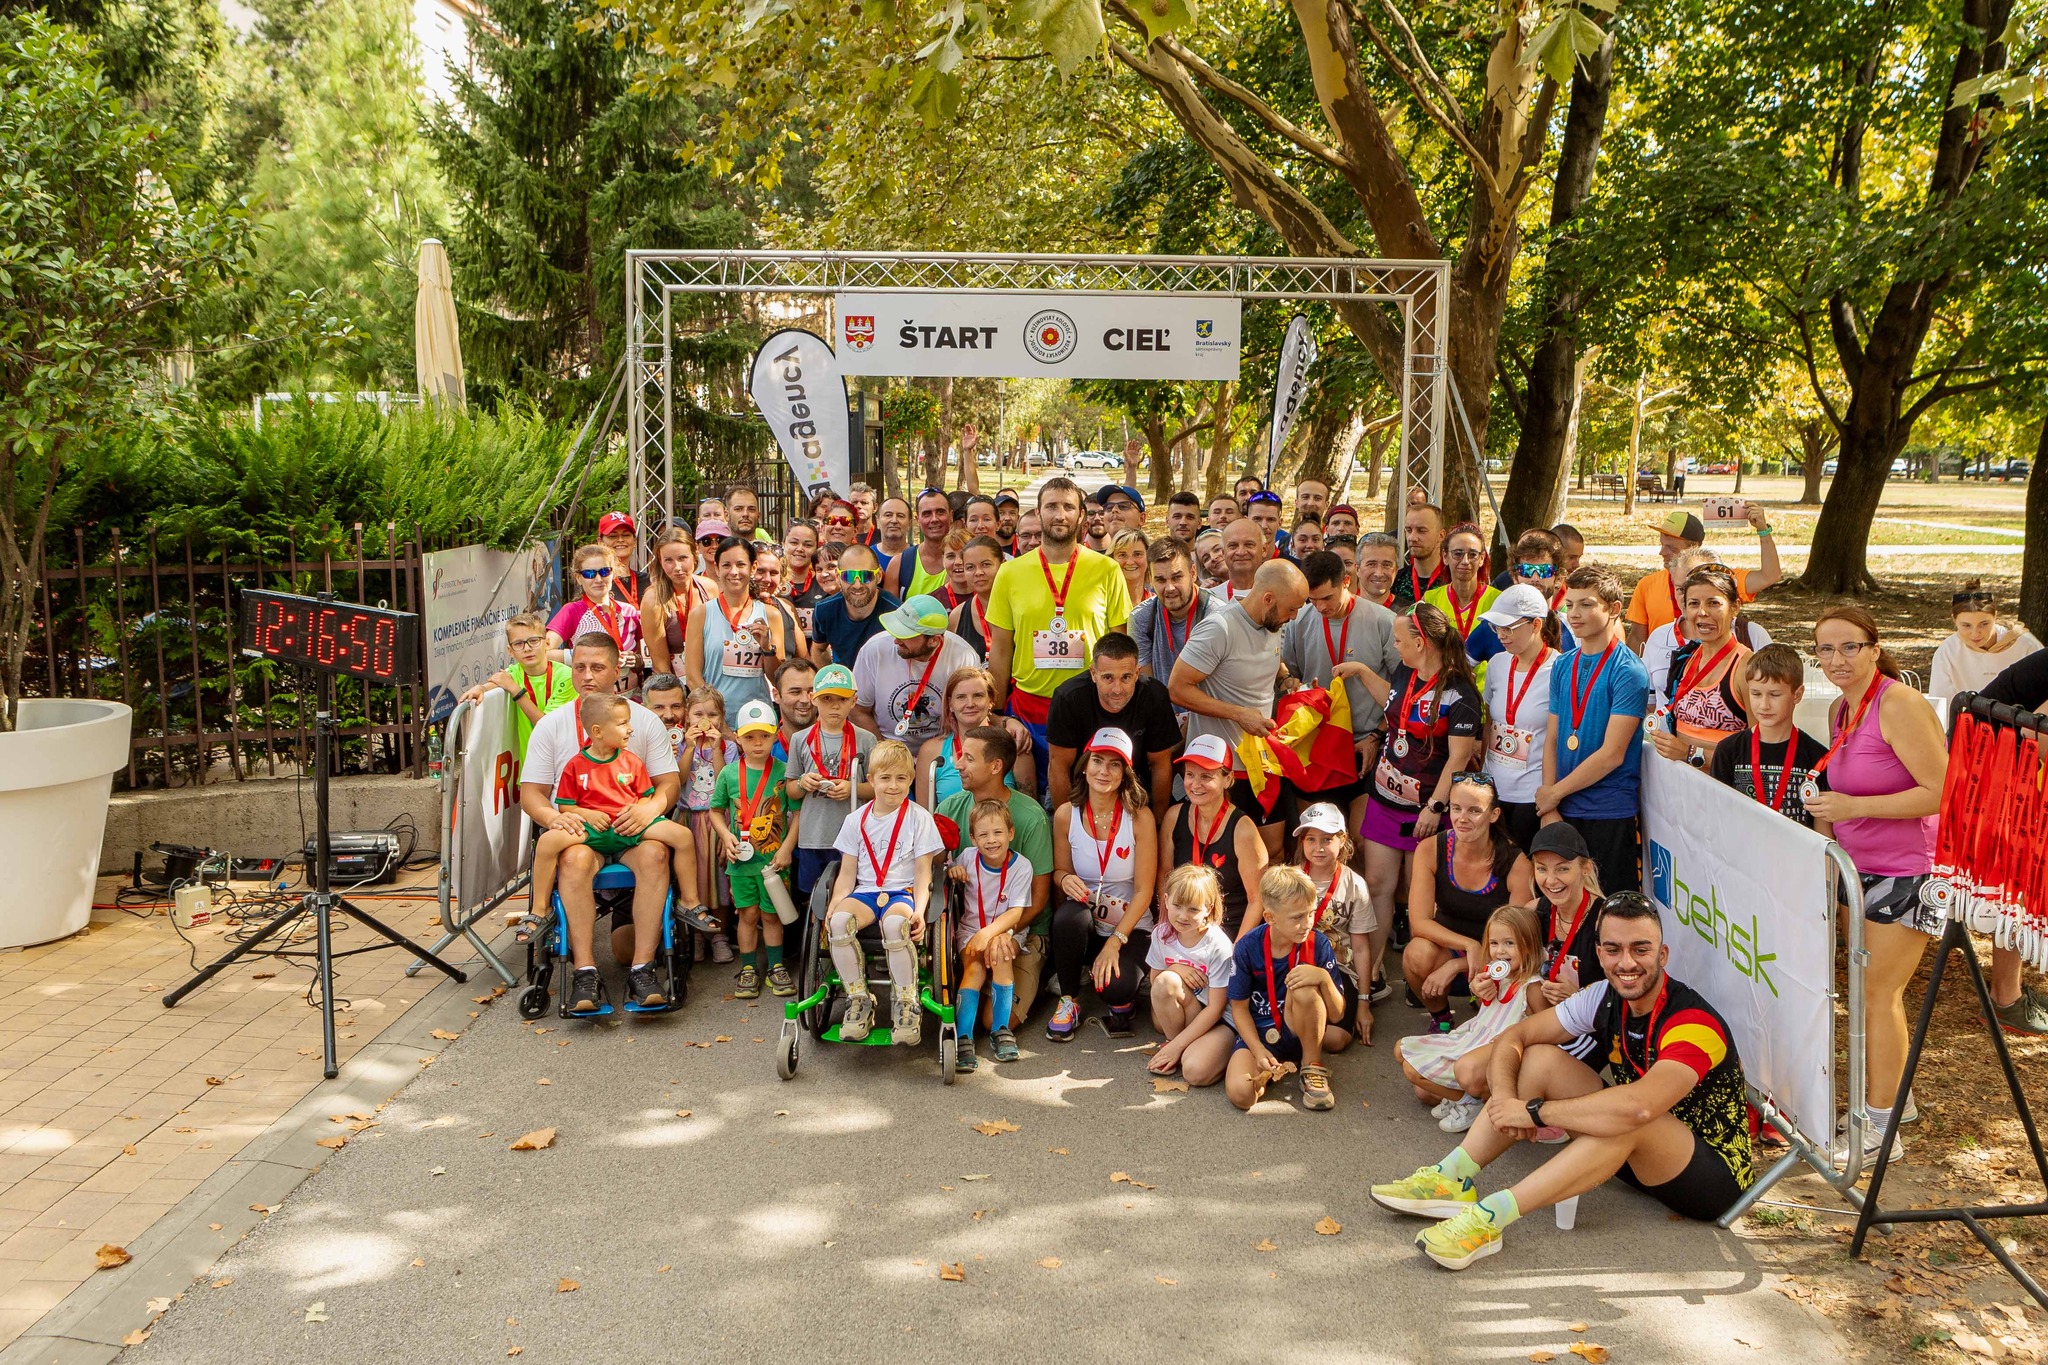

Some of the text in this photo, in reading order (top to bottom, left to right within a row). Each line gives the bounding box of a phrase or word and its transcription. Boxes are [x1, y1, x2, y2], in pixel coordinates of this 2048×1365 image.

[899, 319, 998, 349] ŠTART
[1103, 328, 1171, 351] CIEĽ
[1280, 329, 1308, 433] agency
[1717, 505, 1734, 518] 61
[433, 615, 470, 643] KOMPLEXNÉ
[471, 606, 501, 630] FINANČNÉ
[255, 601, 395, 677] 12:16:50
[1048, 641, 1069, 656] 38
[735, 651, 762, 666] 127
[579, 773, 588, 790] 7
[1387, 776, 1404, 796] 64
[1088, 901, 1108, 920] 70
[1674, 856, 1779, 999] beh.sk
